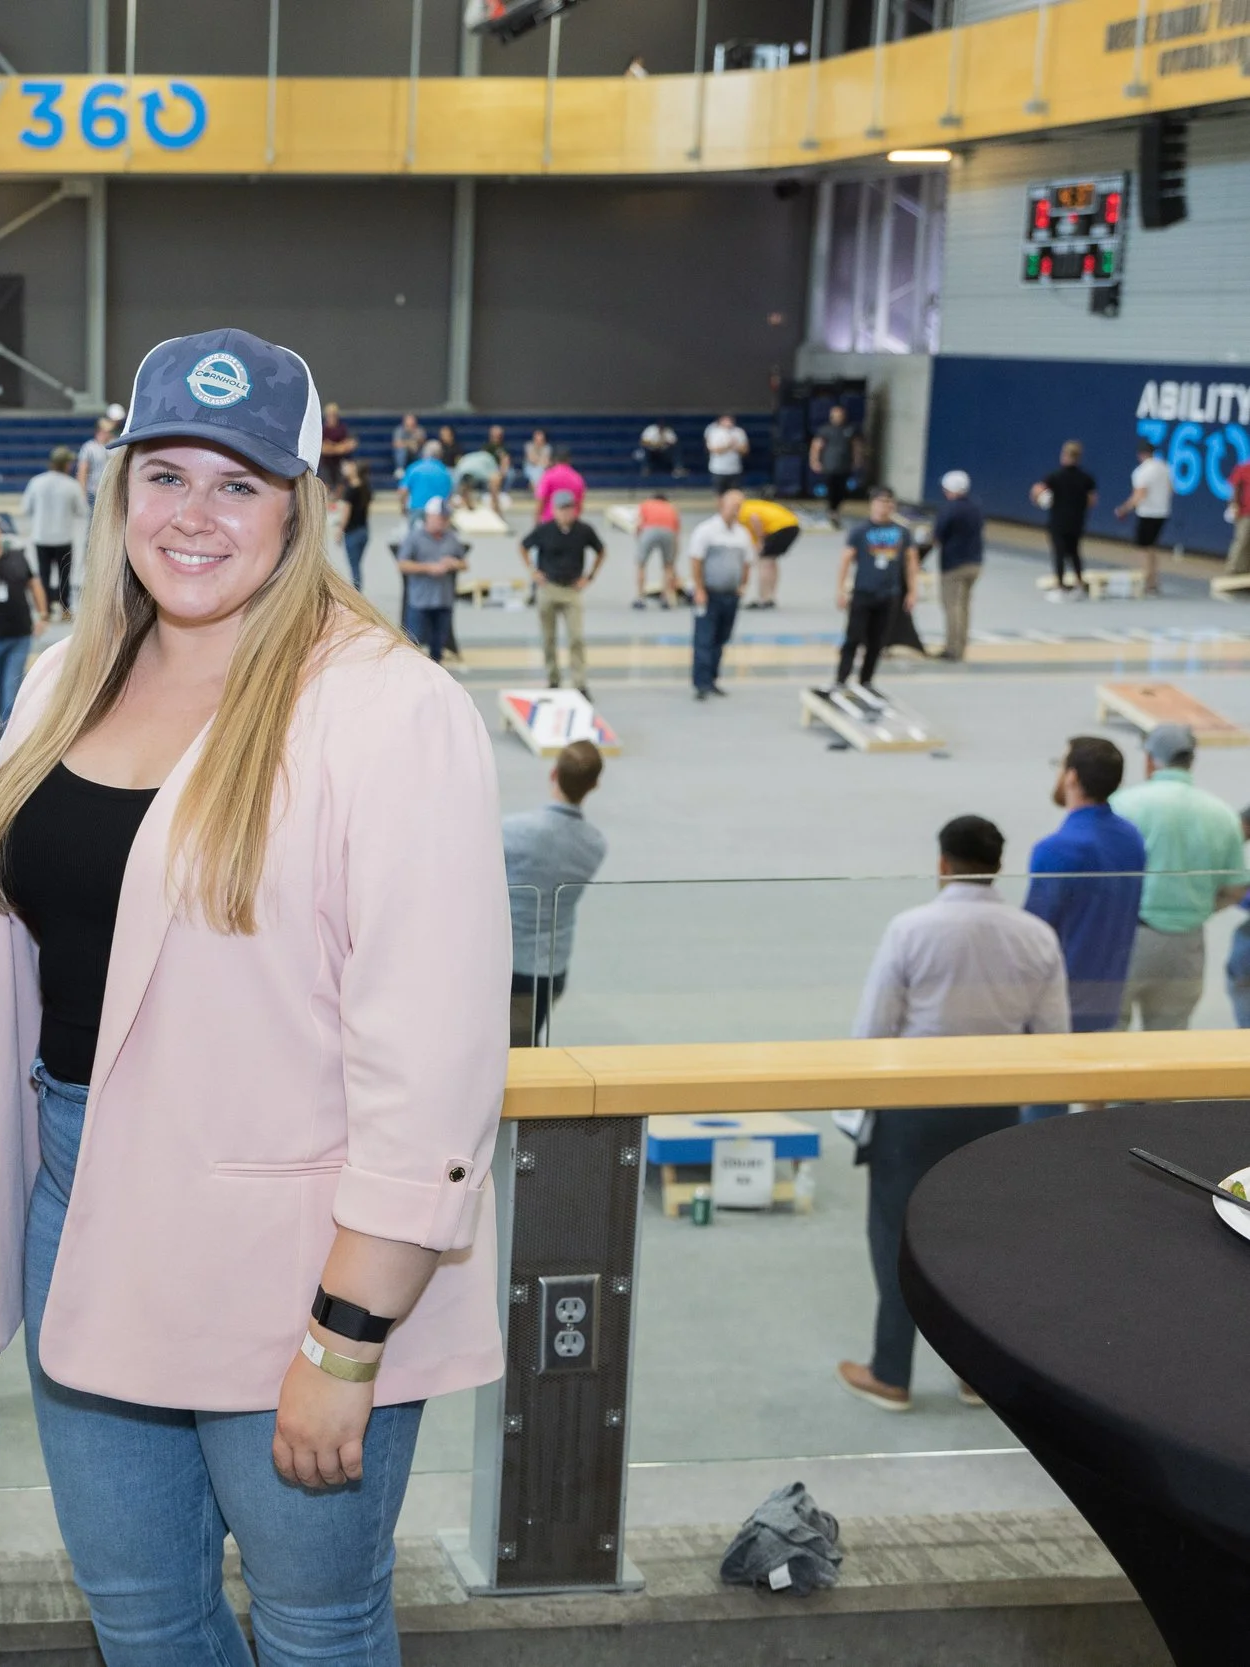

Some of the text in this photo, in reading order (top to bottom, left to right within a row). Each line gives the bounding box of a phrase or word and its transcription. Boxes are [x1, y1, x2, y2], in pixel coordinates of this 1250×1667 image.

[19, 81, 208, 151] 360
[195, 370, 248, 391] CORNHOLE
[203, 396, 231, 406] CLASSIC
[1136, 379, 1250, 425] ABILITY
